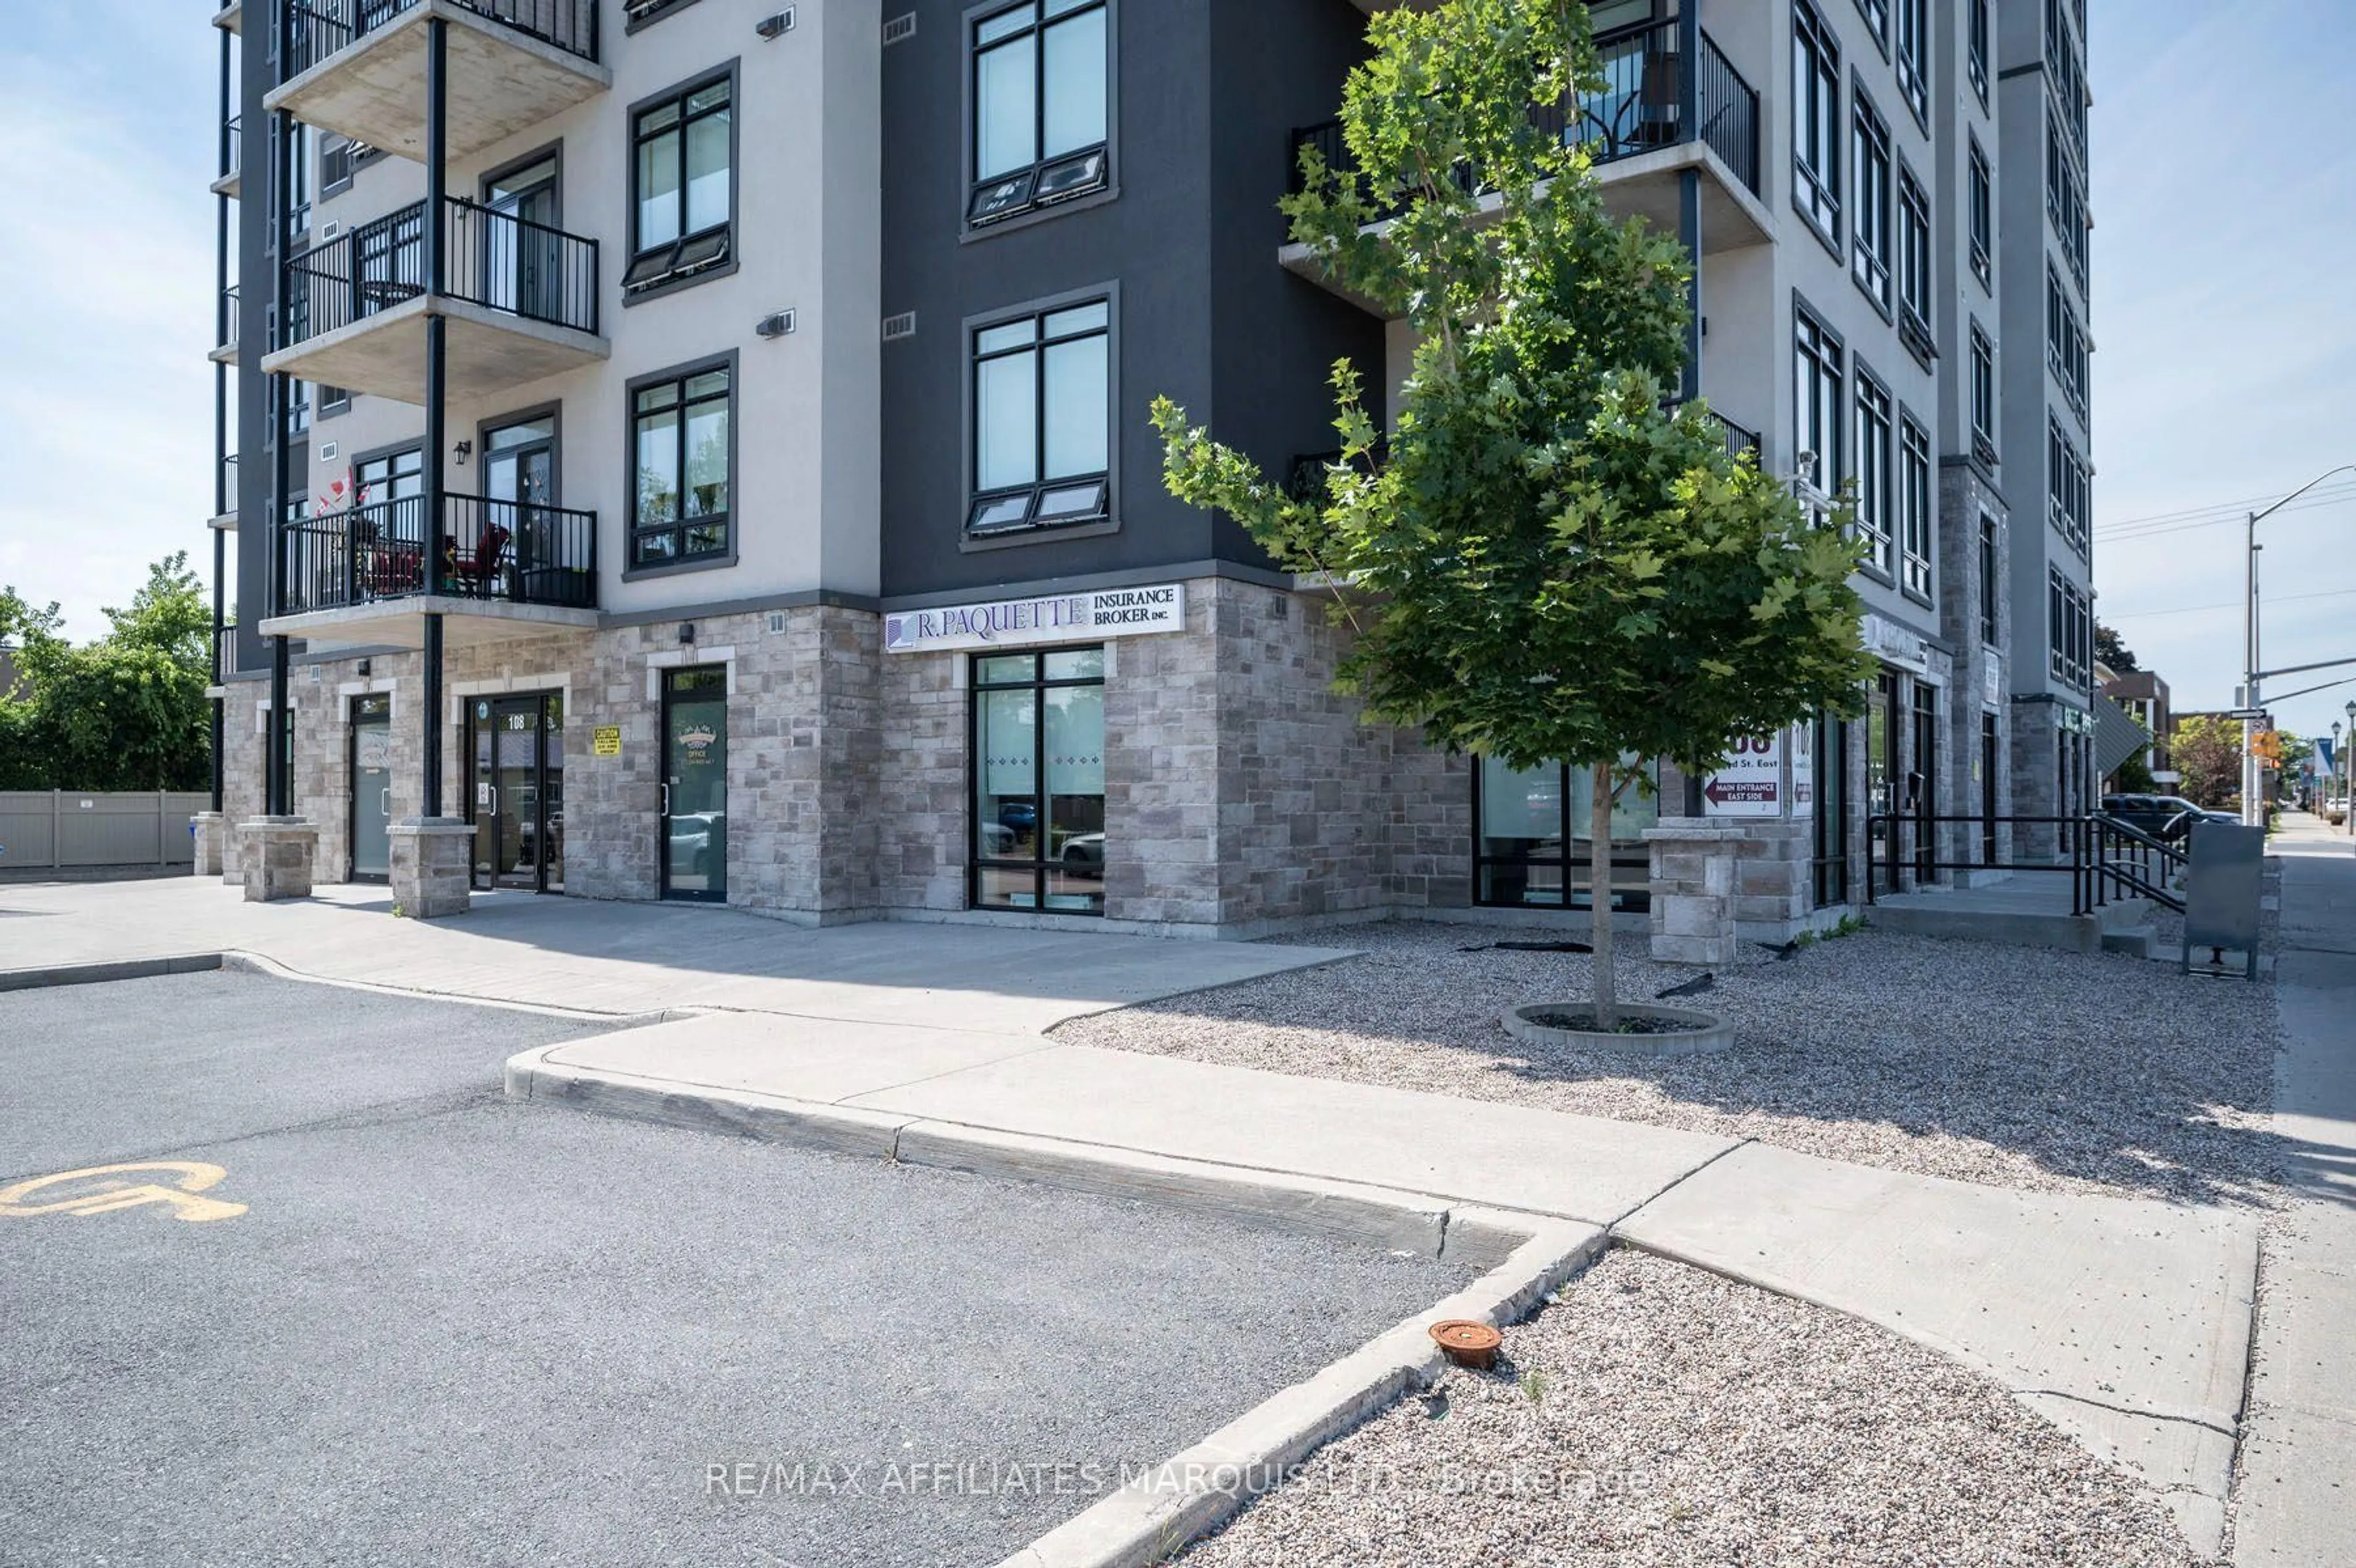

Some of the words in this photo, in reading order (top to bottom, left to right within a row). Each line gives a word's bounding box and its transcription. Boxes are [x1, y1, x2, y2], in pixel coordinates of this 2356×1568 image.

[1094, 589, 1174, 609] INSURANCE
[1095, 609, 1150, 625] BROKER
[1757, 759, 1777, 768] East
[1716, 783, 1735, 792] MAIN
[1736, 783, 1774, 791] ENTRANCE
